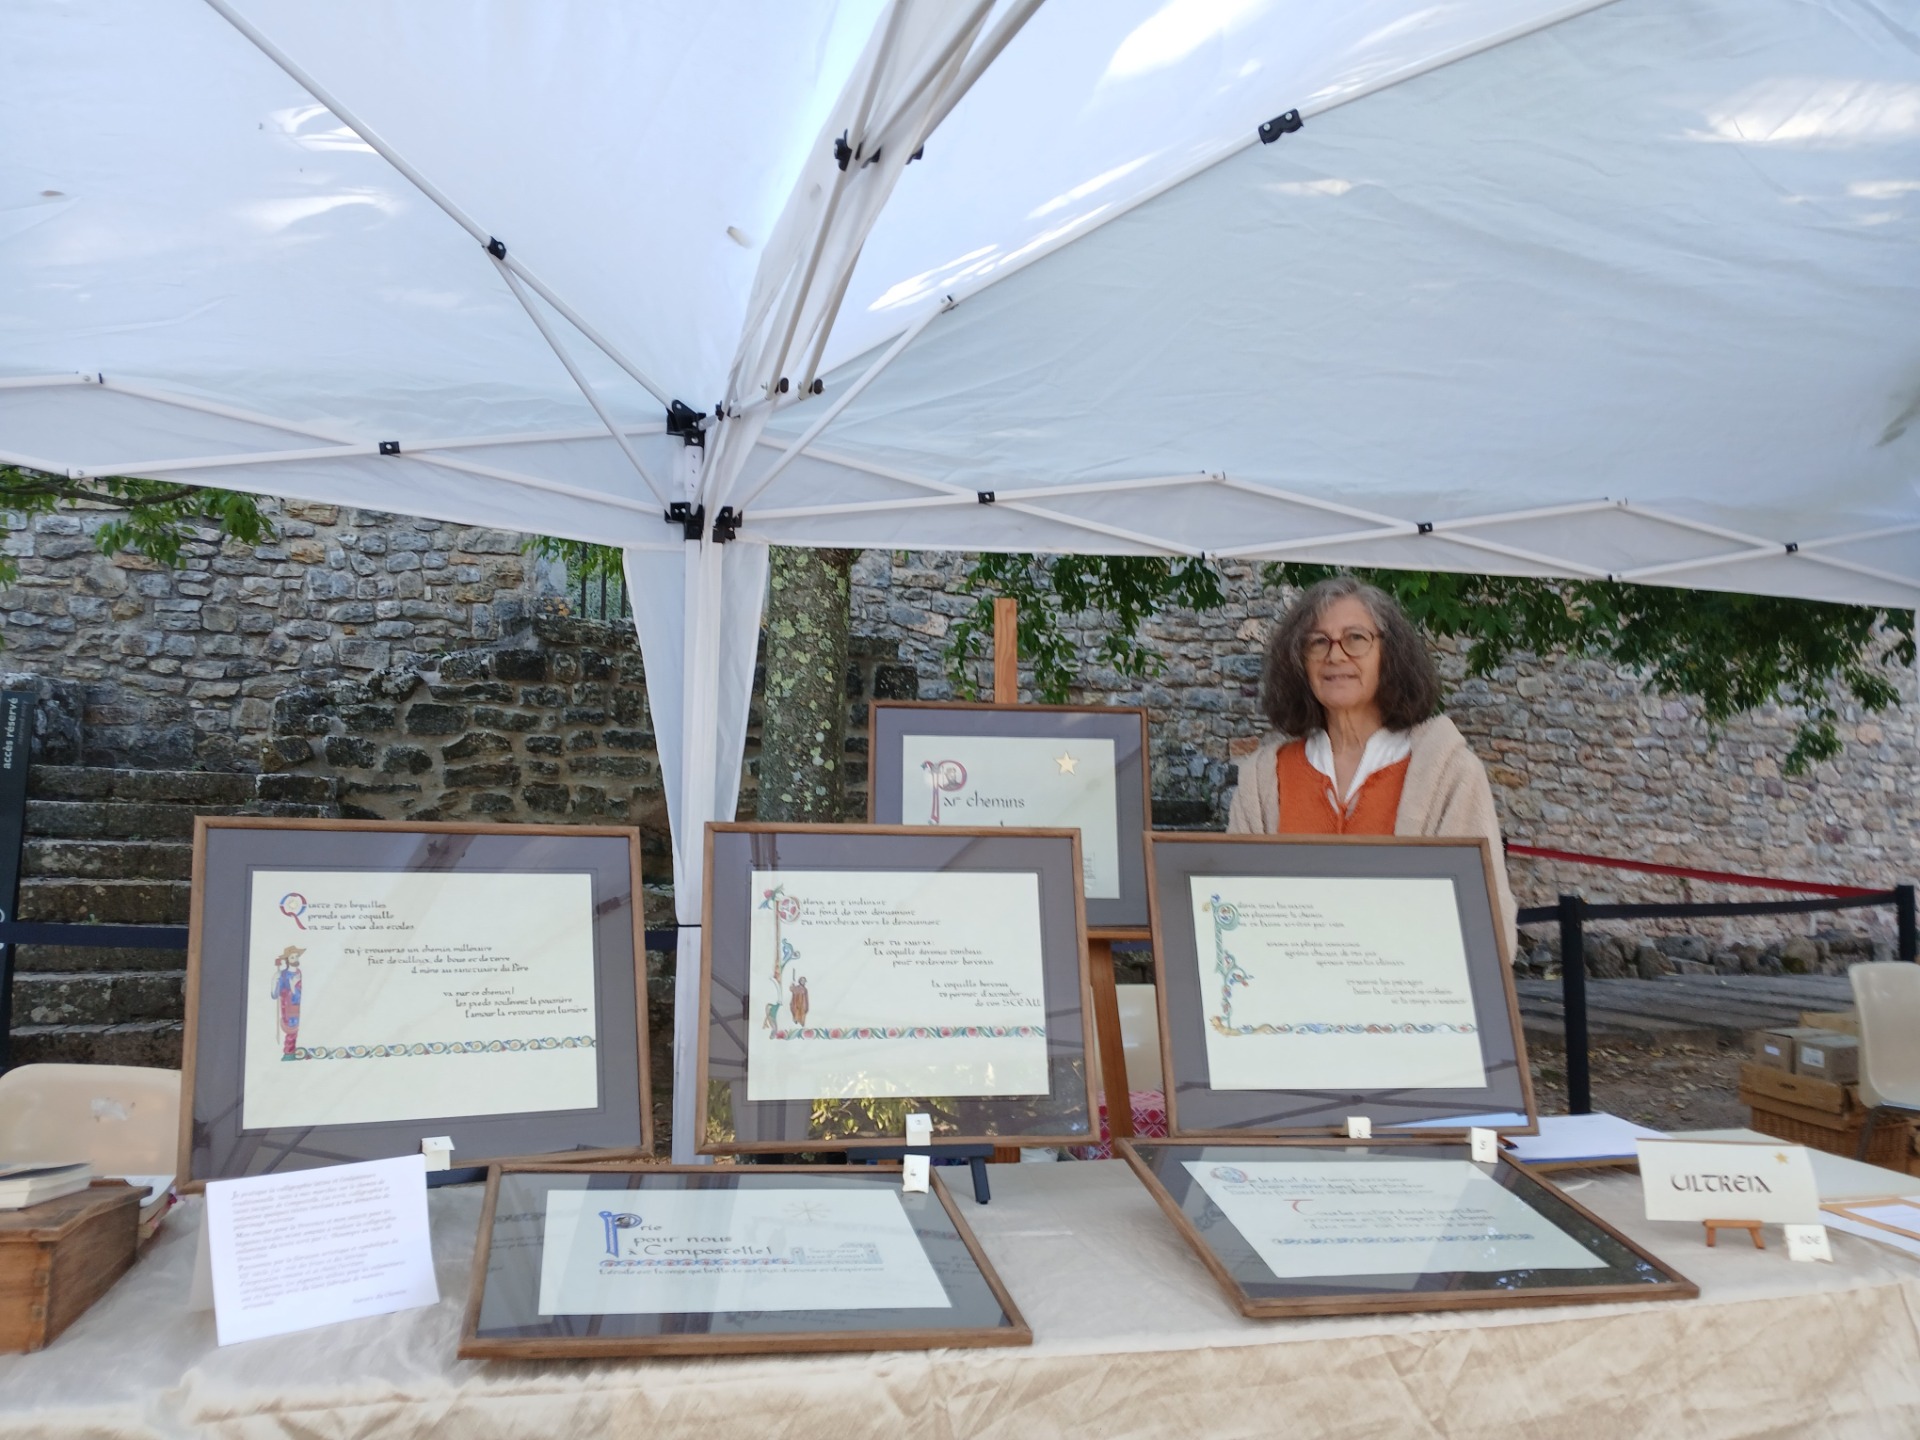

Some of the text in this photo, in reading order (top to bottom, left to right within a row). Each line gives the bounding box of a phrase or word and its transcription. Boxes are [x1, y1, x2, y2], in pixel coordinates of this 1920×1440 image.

[2, 697, 18, 769] accès réservé
[966, 790, 1026, 809] chemins
[307, 911, 338, 922] prends
[358, 911, 394, 922] coquille
[337, 921, 346, 931] la
[368, 921, 385, 931] des
[421, 944, 452, 953] chemin
[386, 955, 398, 965] de
[433, 955, 443, 964] de
[478, 955, 489, 963] de
[499, 964, 511, 972] du
[468, 999, 492, 1009] pieds
[530, 996, 537, 1005] la
[497, 1007, 506, 1017] la
[1669, 1174, 1772, 1194] ULTREIA
[633, 1235, 679, 1247] pour
